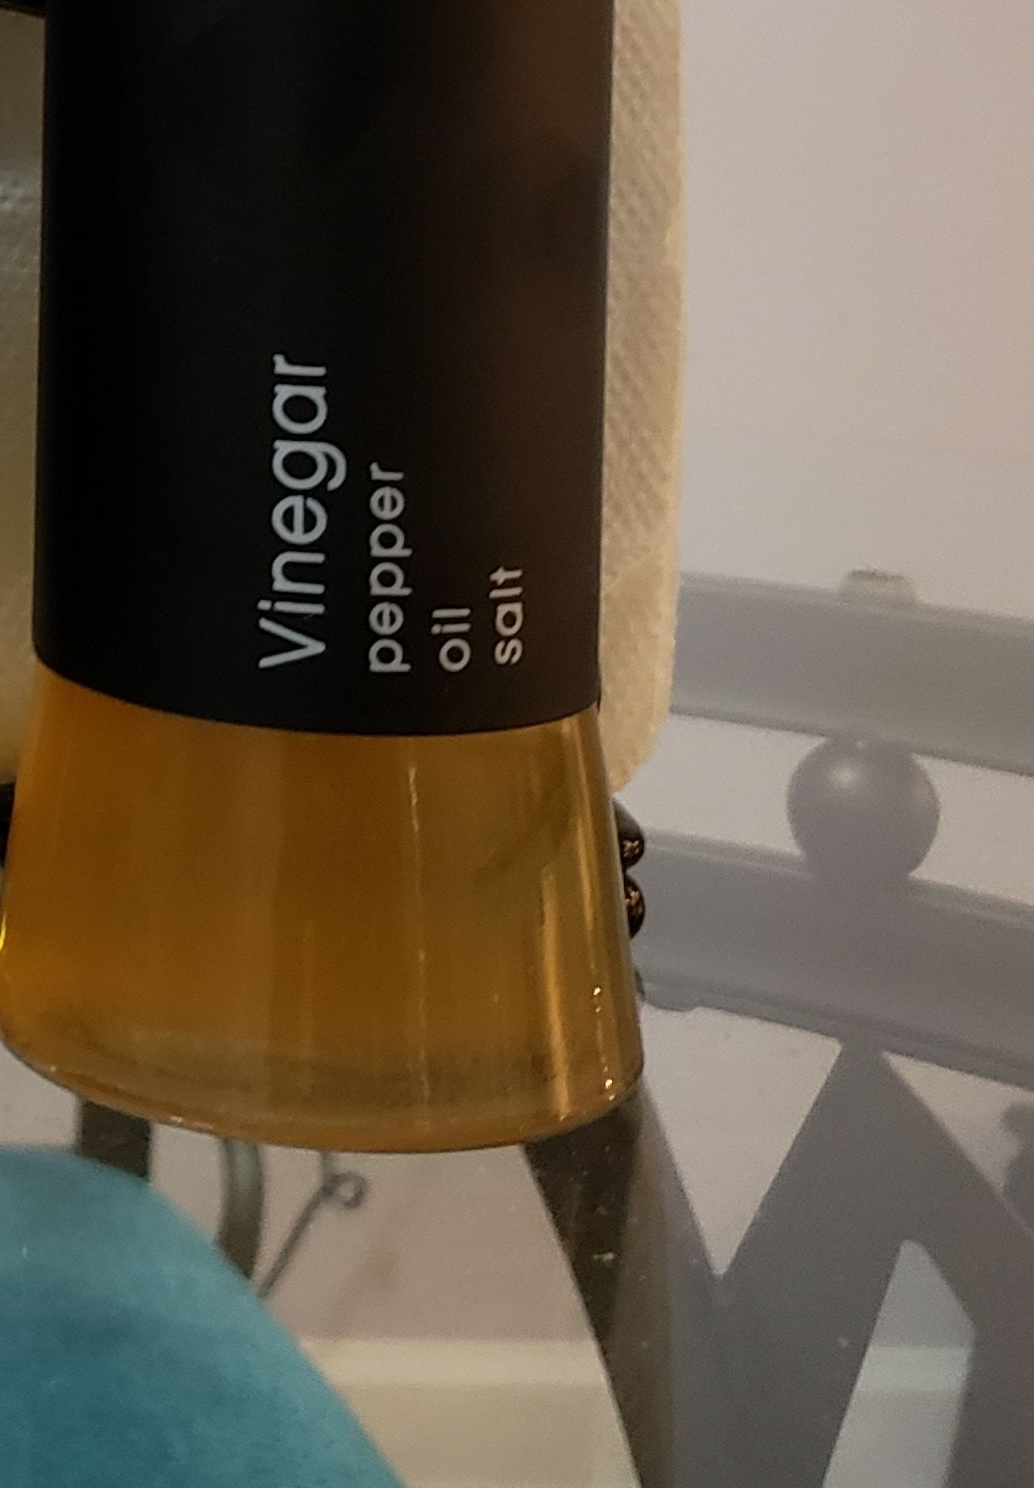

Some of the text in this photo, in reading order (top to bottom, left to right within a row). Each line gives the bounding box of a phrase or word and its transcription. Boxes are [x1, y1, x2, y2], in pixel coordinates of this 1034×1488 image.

[257, 353, 347, 669] Vinegar
[368, 461, 413, 673] pepper
[430, 607, 472, 672] oil
[488, 566, 524, 666] salt
